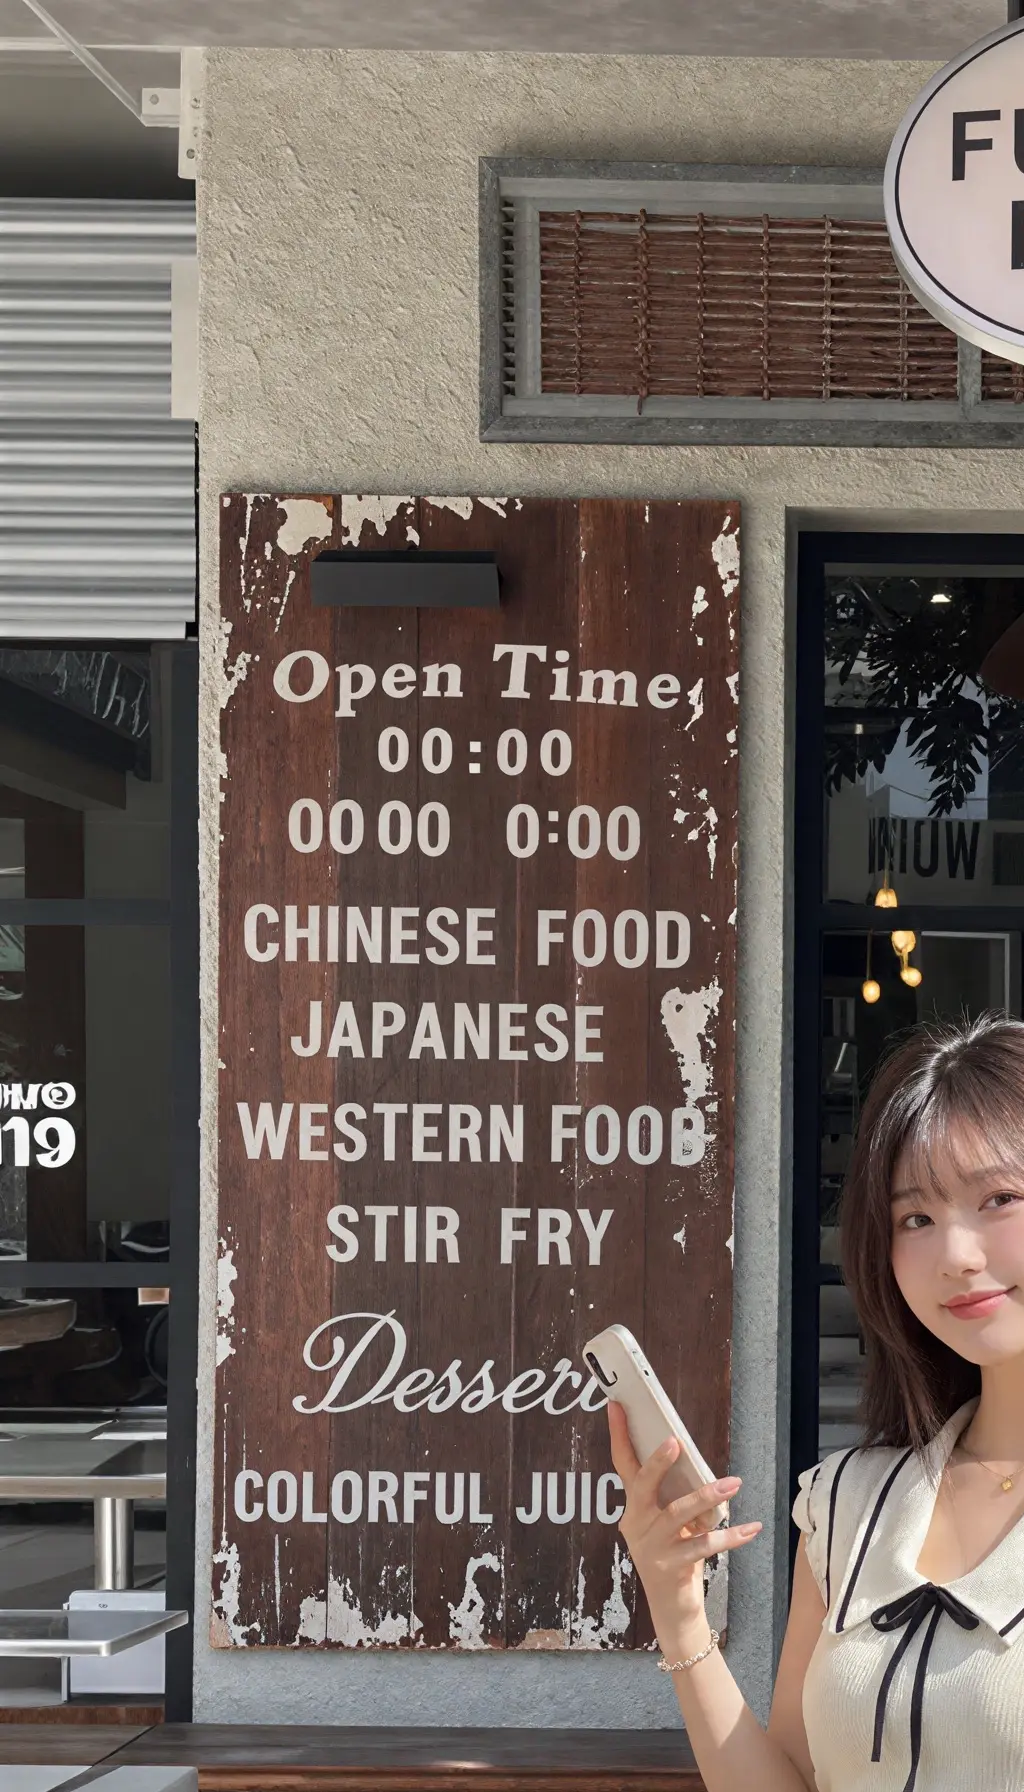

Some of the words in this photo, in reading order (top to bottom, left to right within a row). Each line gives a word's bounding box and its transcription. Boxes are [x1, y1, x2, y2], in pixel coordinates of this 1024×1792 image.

[272, 649, 464, 718] Open
[492, 643, 681, 709] Time
[377, 726, 573, 777] 00:00
[506, 803, 641, 861] 0:00
[243, 903, 496, 966] CHINESE
[537, 908, 691, 969] FOOD
[290, 999, 604, 1062] JAPANESE
[236, 1101, 524, 1163] WESTERN
[325, 1204, 460, 1264] STIR
[500, 1207, 615, 1266] FRY
[234, 1469, 494, 1525] COLORFUL
[515, 1471, 625, 1525] JUIC
